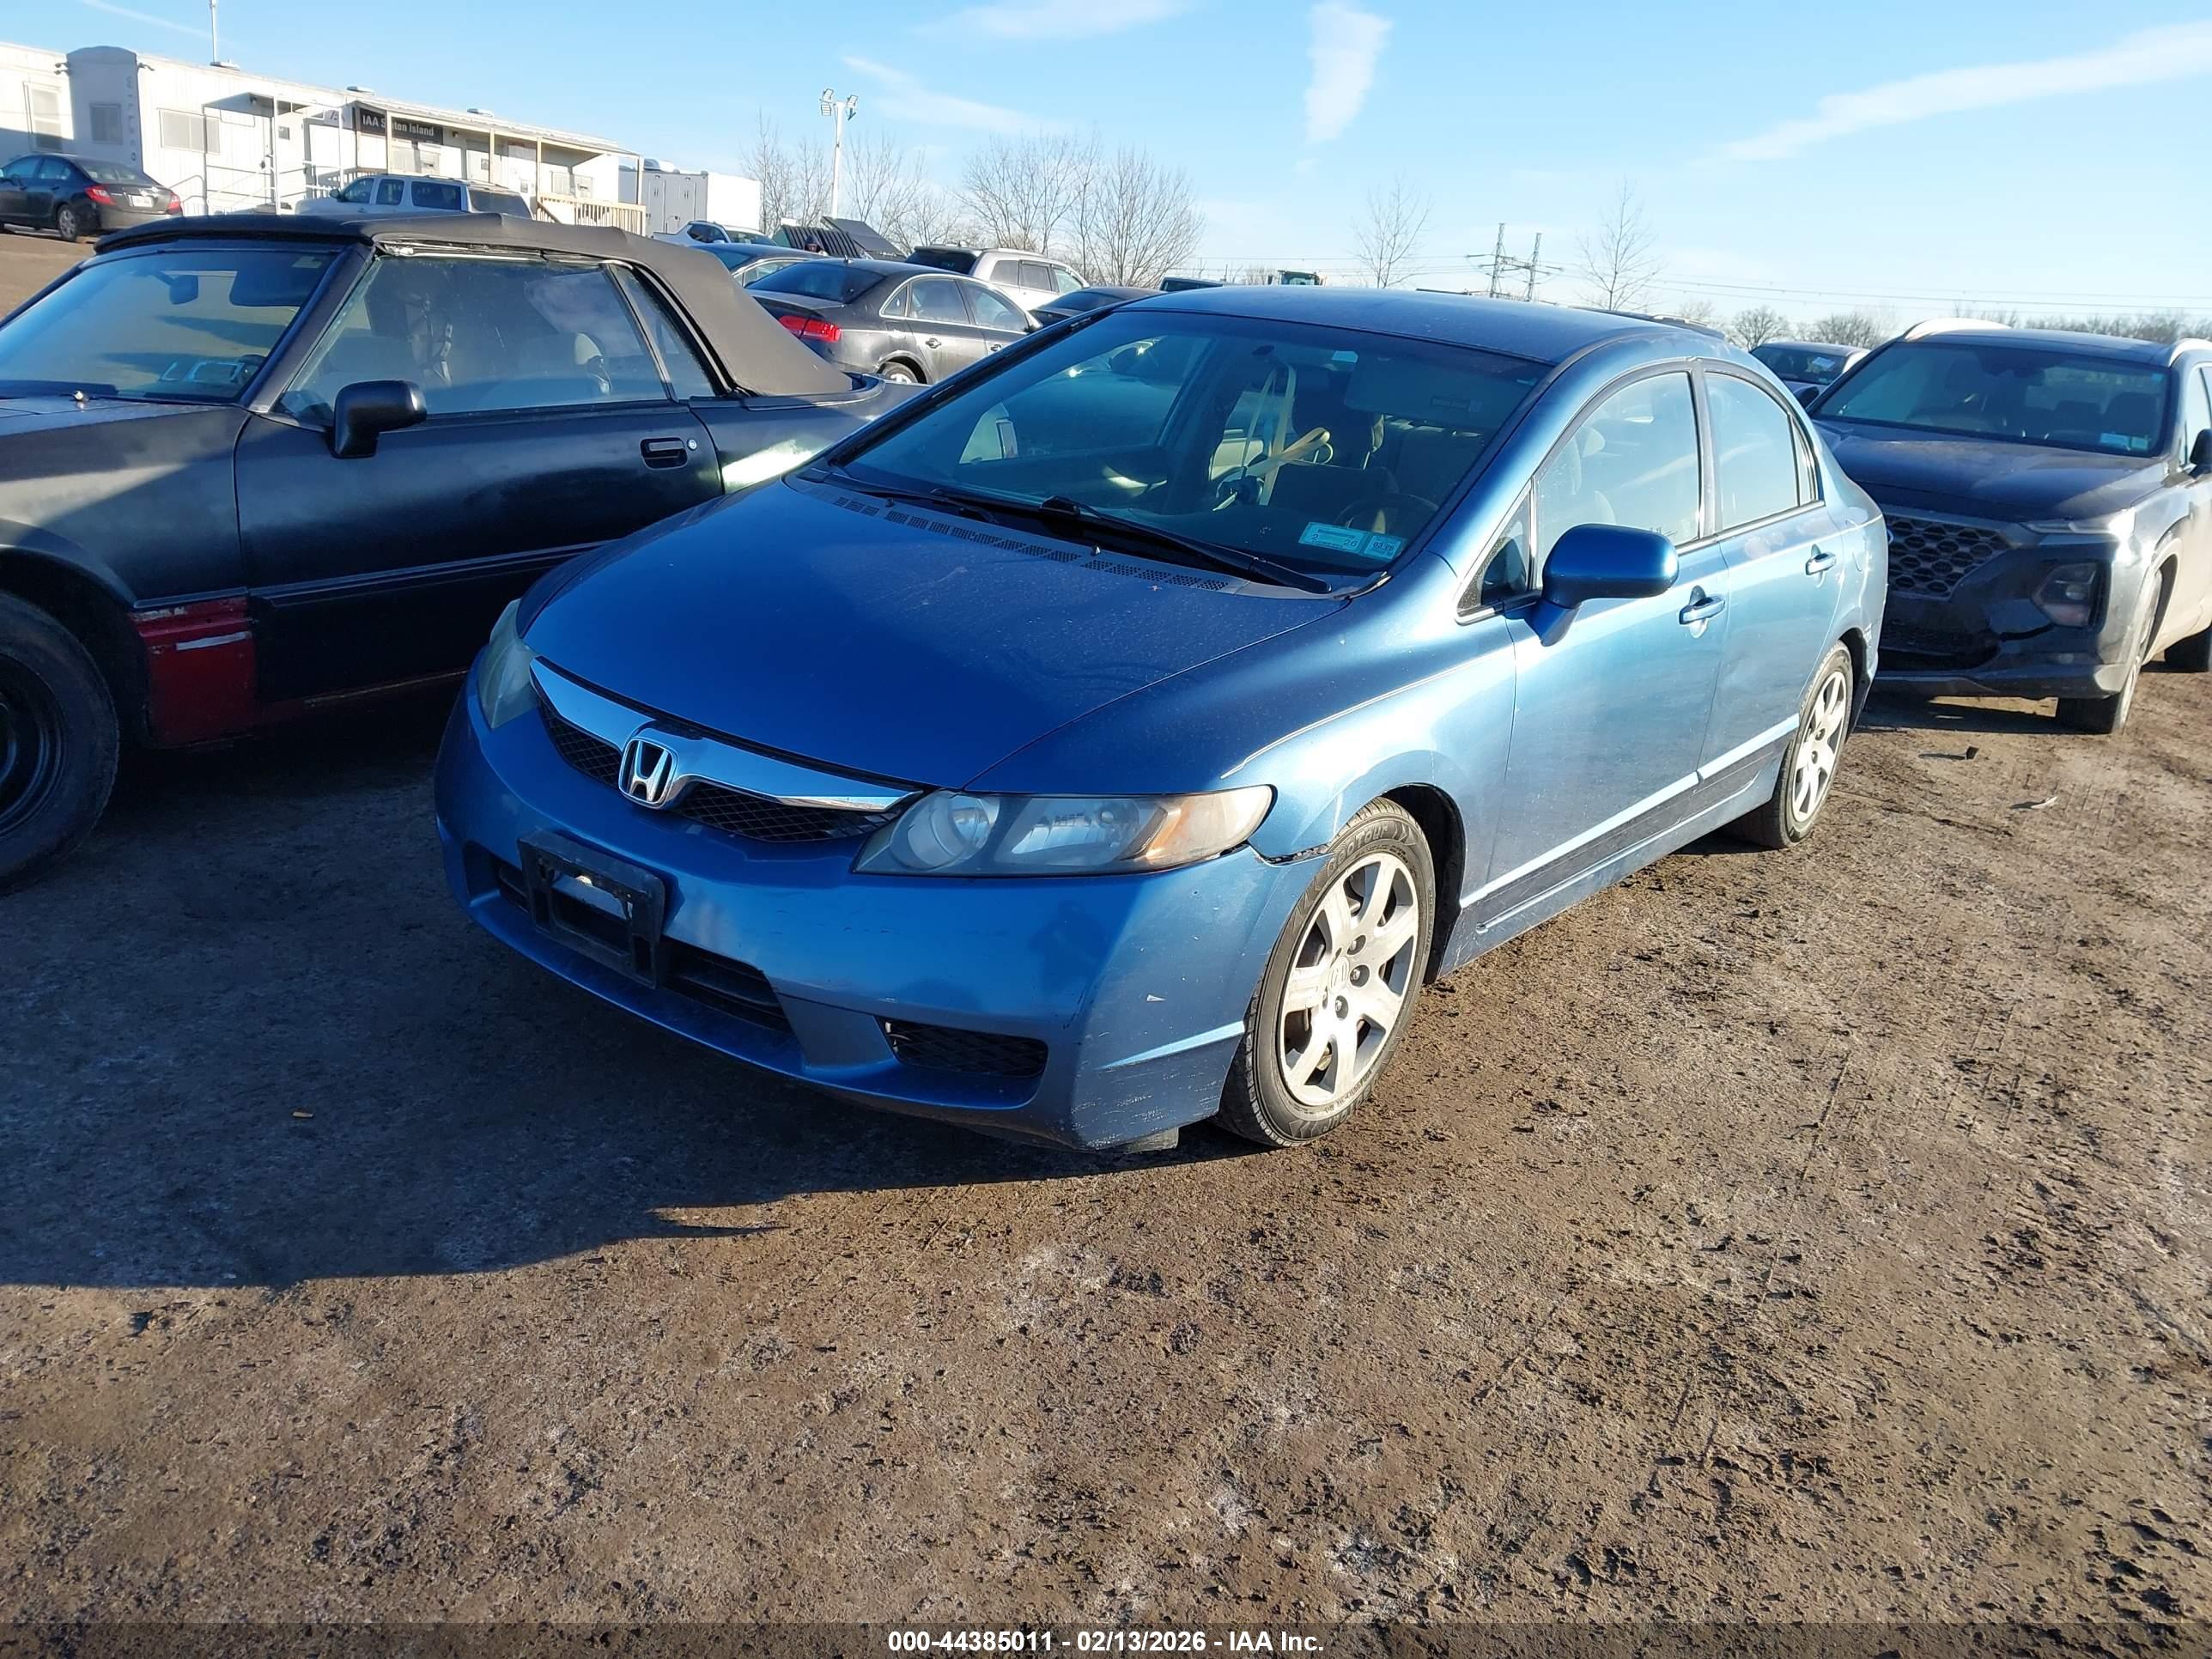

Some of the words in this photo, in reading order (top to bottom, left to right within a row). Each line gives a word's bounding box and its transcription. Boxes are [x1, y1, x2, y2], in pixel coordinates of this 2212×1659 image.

[362, 114, 379, 128] IAA
[380, 118, 407, 132] Sten
[409, 121, 434, 137] Island
[1342, 539, 1358, 548] 26
